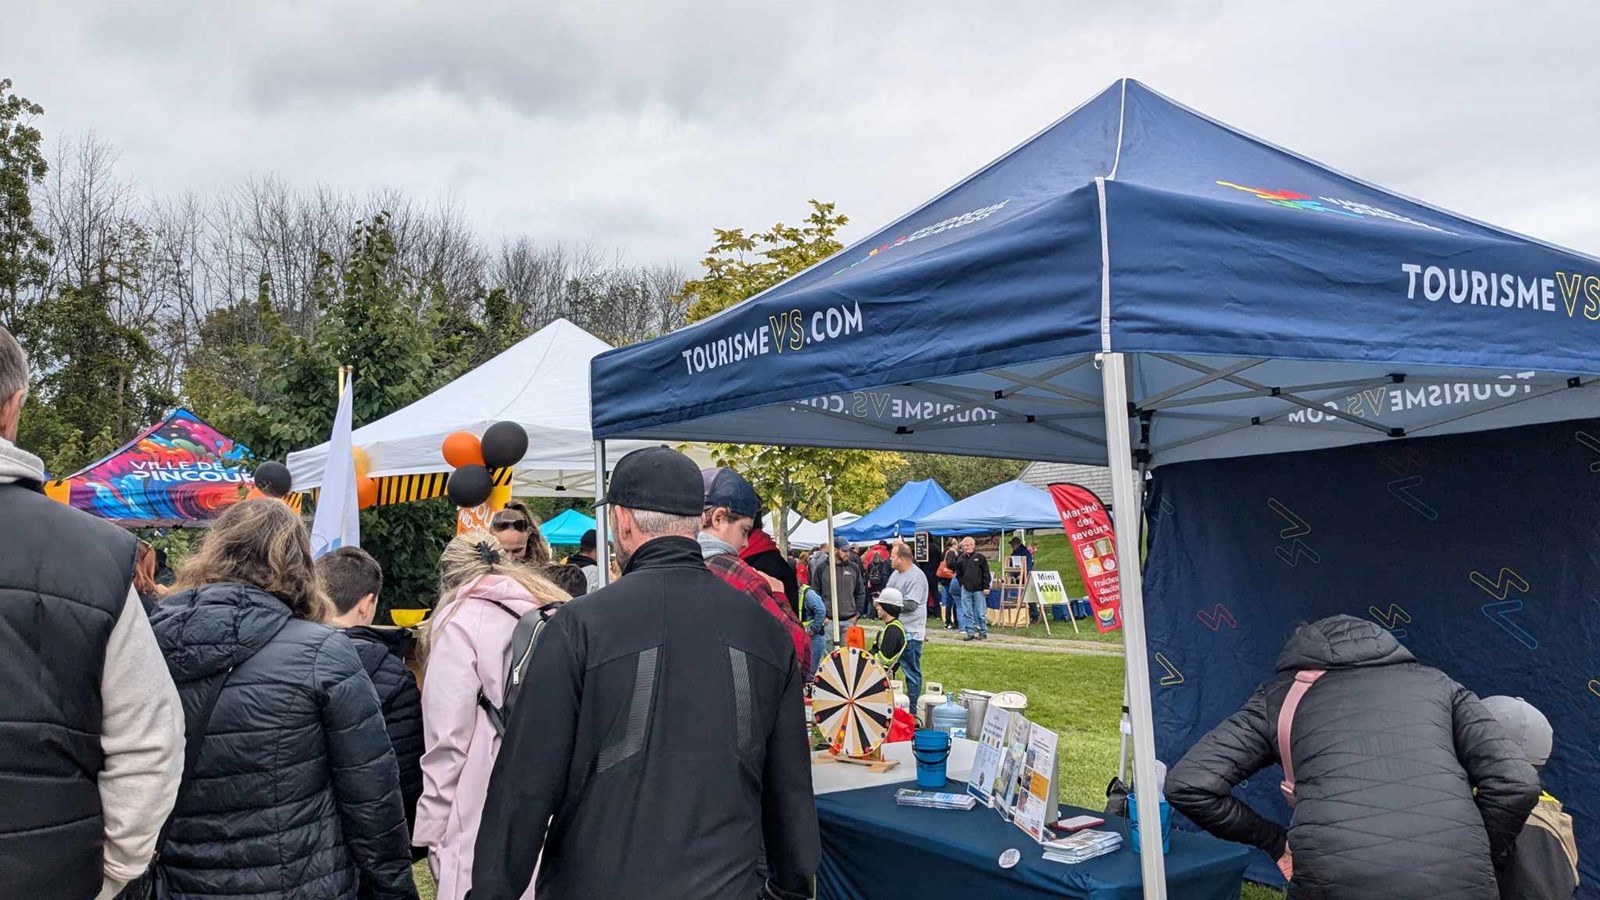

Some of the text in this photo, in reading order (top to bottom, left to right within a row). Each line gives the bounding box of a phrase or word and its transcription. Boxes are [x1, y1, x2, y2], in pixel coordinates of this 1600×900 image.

[130, 461, 227, 472] VILLE DE
[132, 470, 255, 483] PINCOUR
[1062, 501, 1099, 520] Marché
[1077, 517, 1095, 528] des
[1071, 524, 1110, 541] saveurs
[1037, 573, 1056, 581] Mini
[1037, 582, 1062, 592] kiwi
